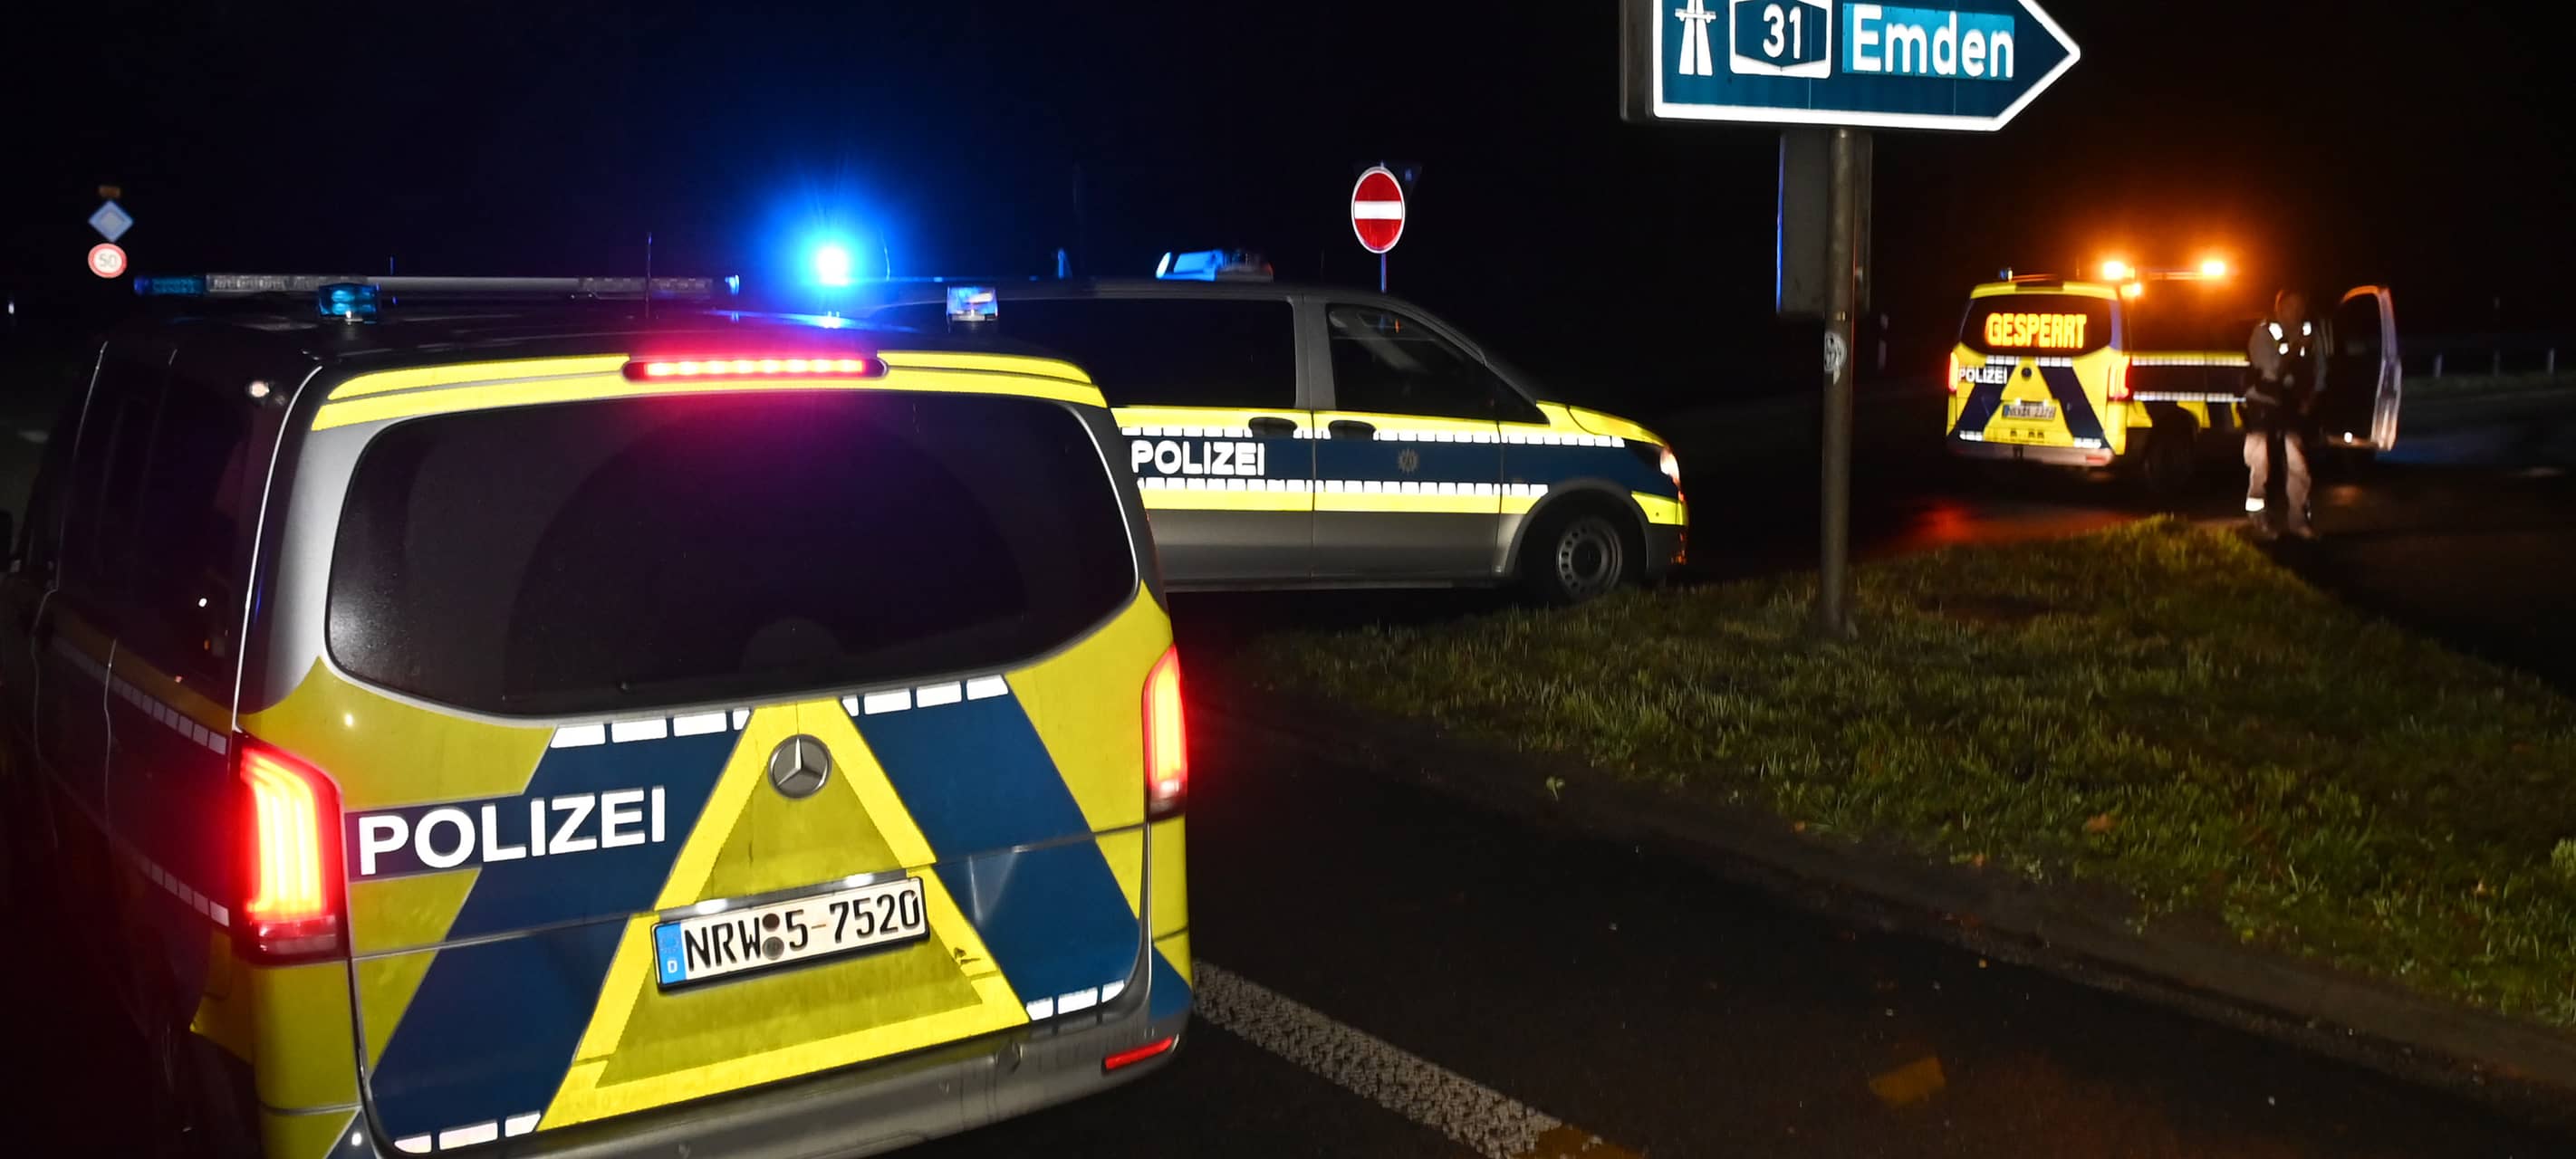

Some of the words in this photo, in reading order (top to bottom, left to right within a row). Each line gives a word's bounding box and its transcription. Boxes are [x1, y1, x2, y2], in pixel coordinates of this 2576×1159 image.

[1762, 3, 1802, 60] 31
[1852, 4, 2014, 79] Emden
[99, 253, 118, 268] 50
[1985, 312, 2087, 349] GESPERRT
[1958, 366, 2007, 385] POLIZEI
[1130, 439, 1265, 476] POLIZEI
[358, 785, 666, 876] POLIZEI
[684, 916, 761, 972] NRW
[667, 960, 678, 974] D
